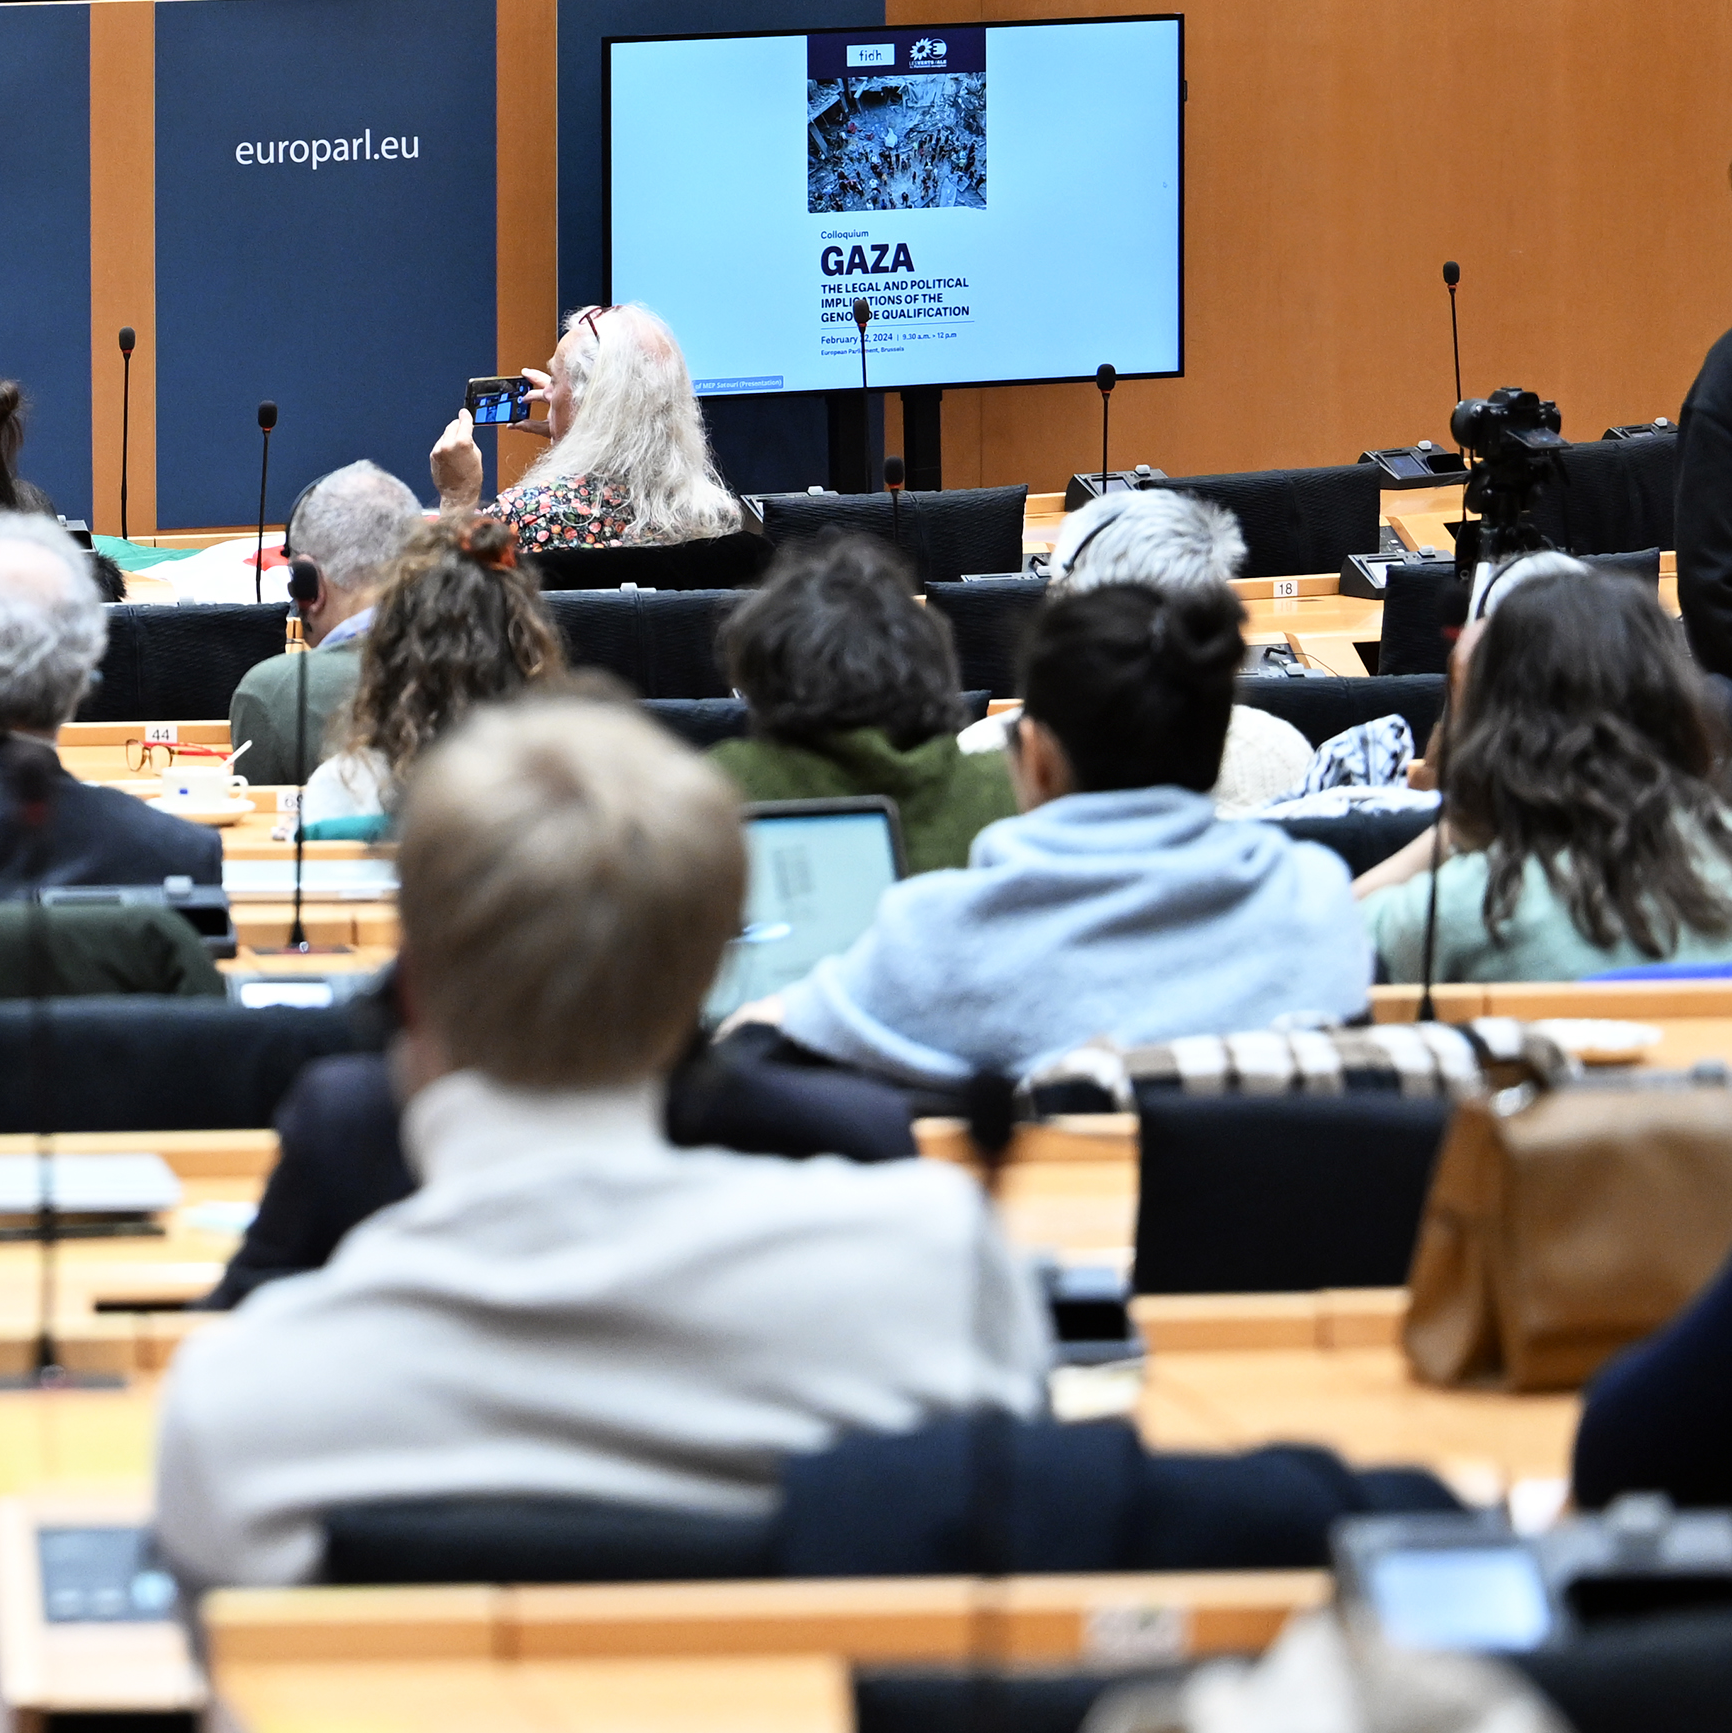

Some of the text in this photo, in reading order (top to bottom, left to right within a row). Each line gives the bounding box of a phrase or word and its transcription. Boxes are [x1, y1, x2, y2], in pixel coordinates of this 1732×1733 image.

[235, 130, 419, 170] europarl.eu
[821, 229, 869, 240] Colloquium
[821, 243, 915, 276] GAZA
[821, 278, 969, 294] THE LEGAL AND POLITICAL
[821, 293, 943, 308] IMPLITIONS OF THE
[882, 306, 970, 319] QUALIFICATION
[821, 335, 858, 345] February
[873, 333, 893, 341] 2024
[1279, 583, 1292, 595] 18
[152, 729, 169, 740] 44
